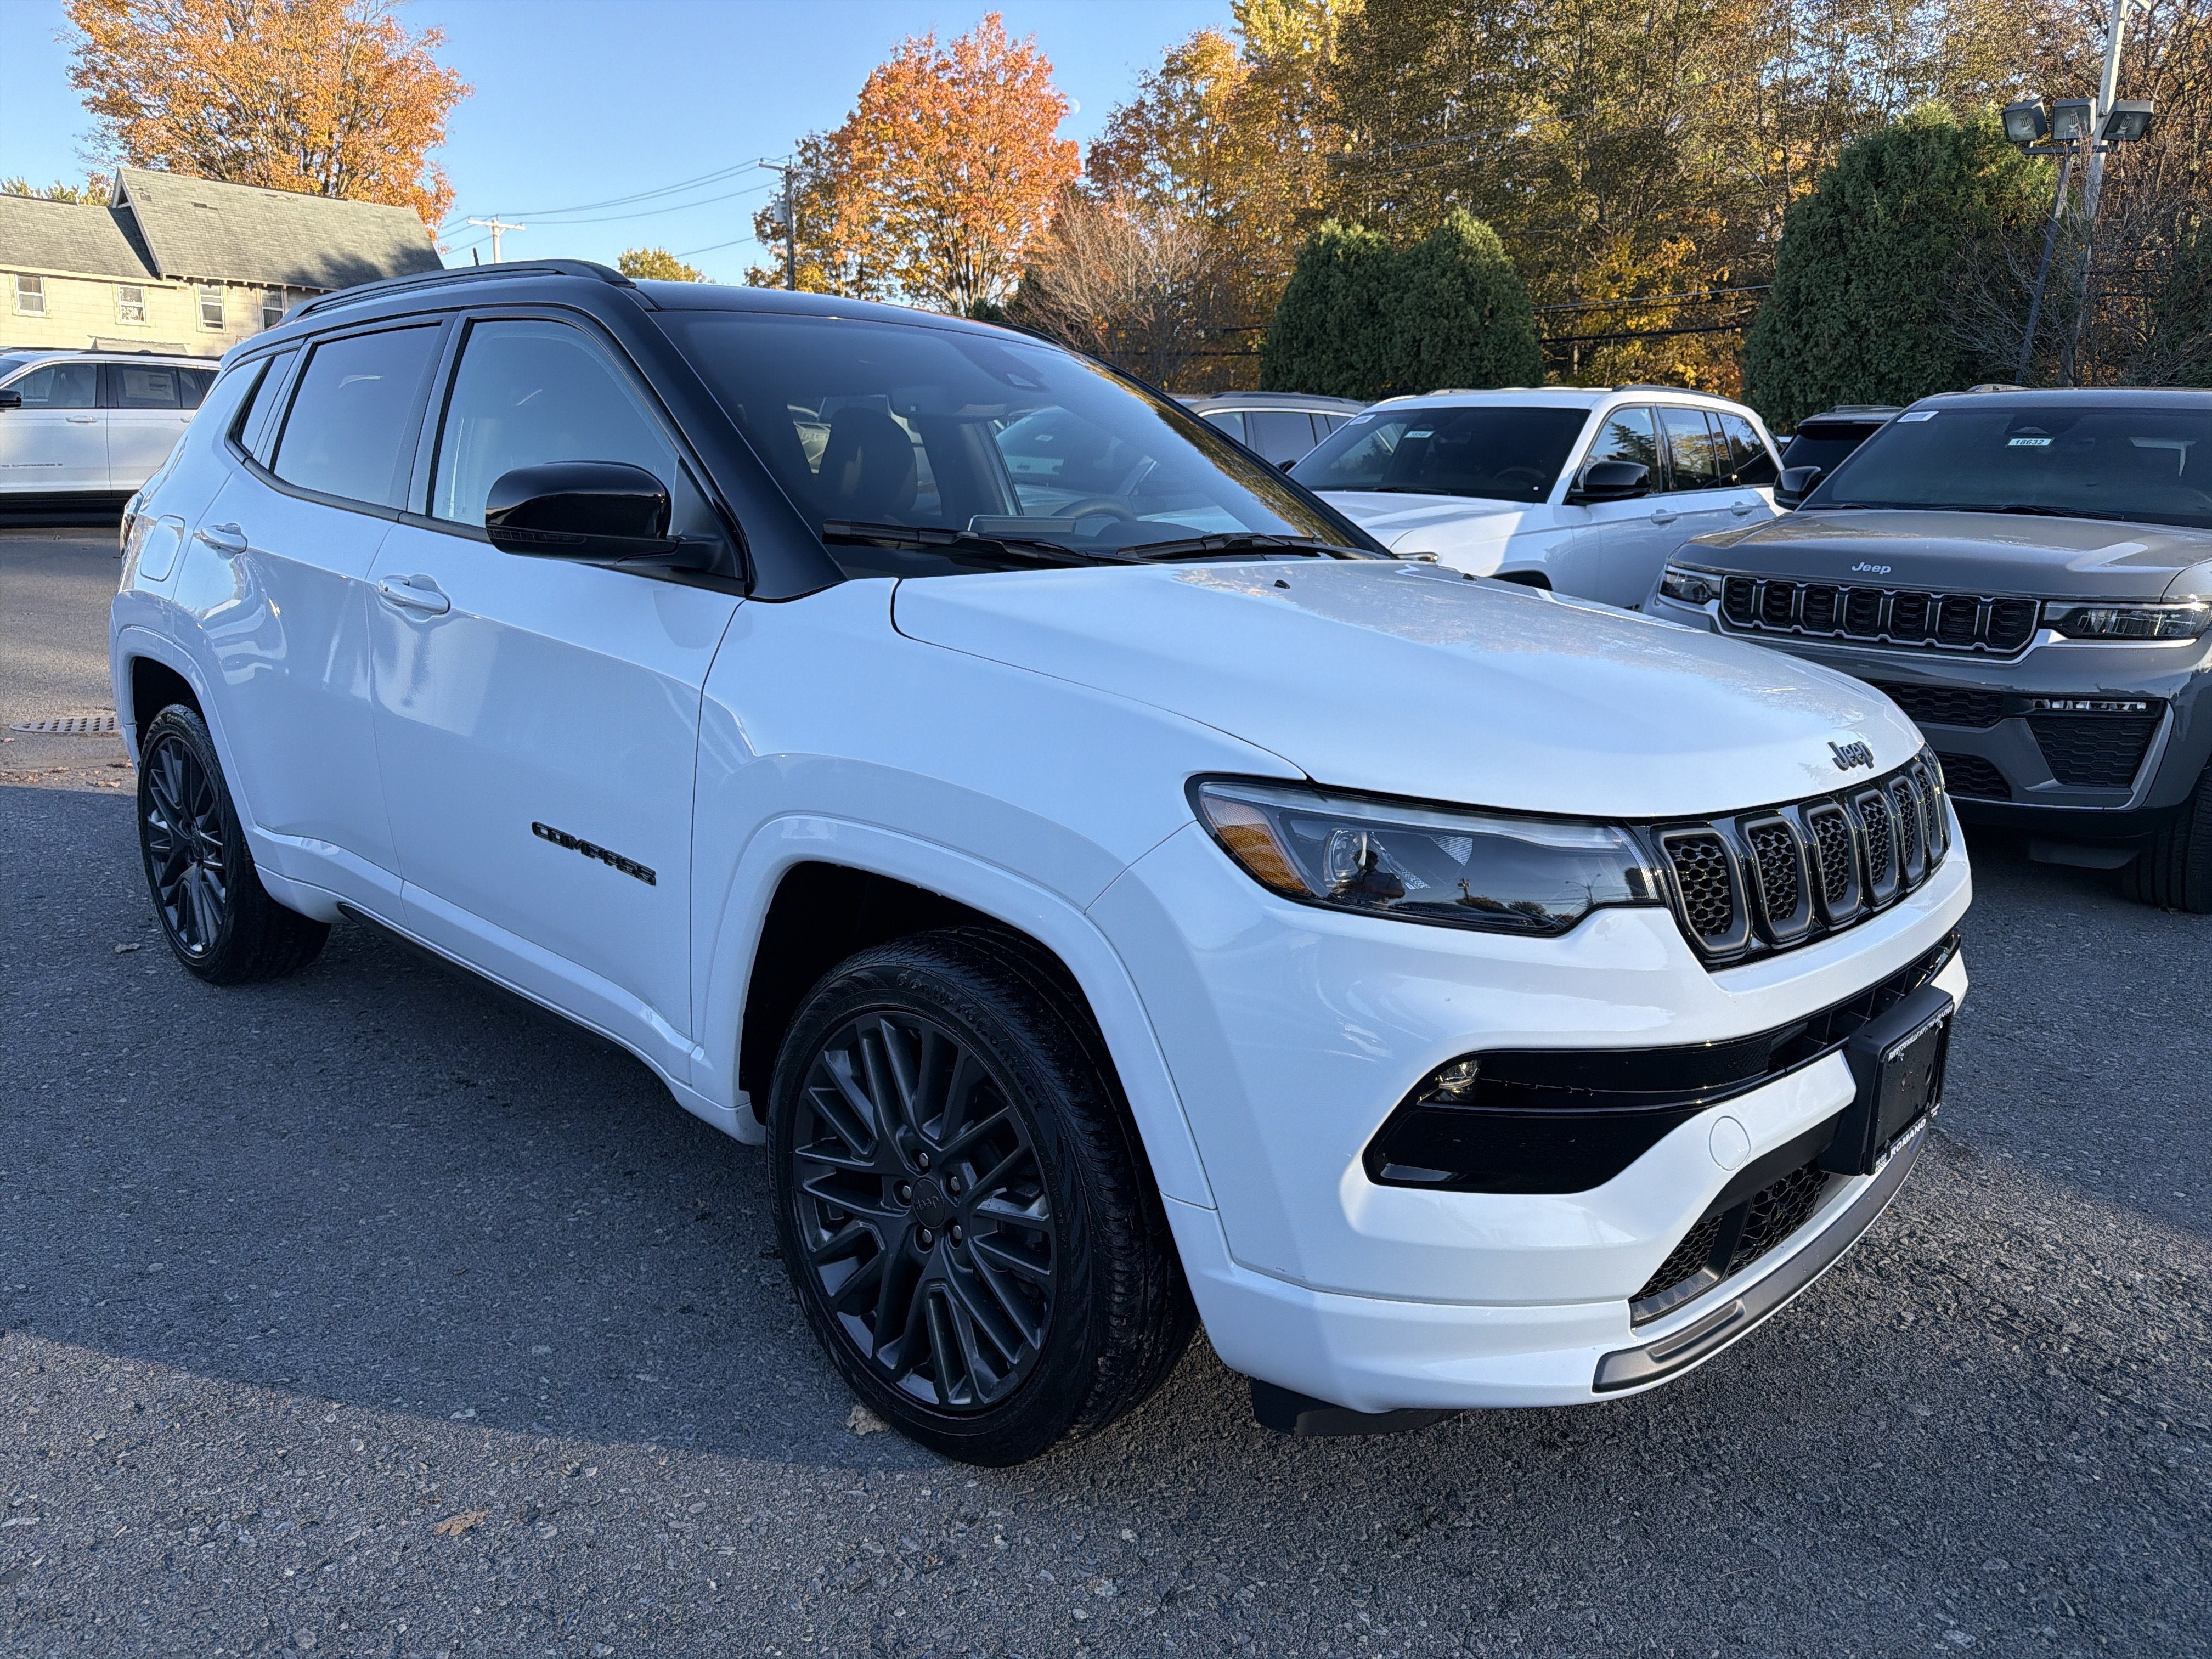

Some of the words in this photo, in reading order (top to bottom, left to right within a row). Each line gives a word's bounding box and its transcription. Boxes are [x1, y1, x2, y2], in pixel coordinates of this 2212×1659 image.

[1852, 562, 1892, 575] Jeep
[1827, 741, 1874, 771] Jeep
[532, 821, 656, 886] COMPASS
[1891, 1118, 1926, 1158] ROMANO
